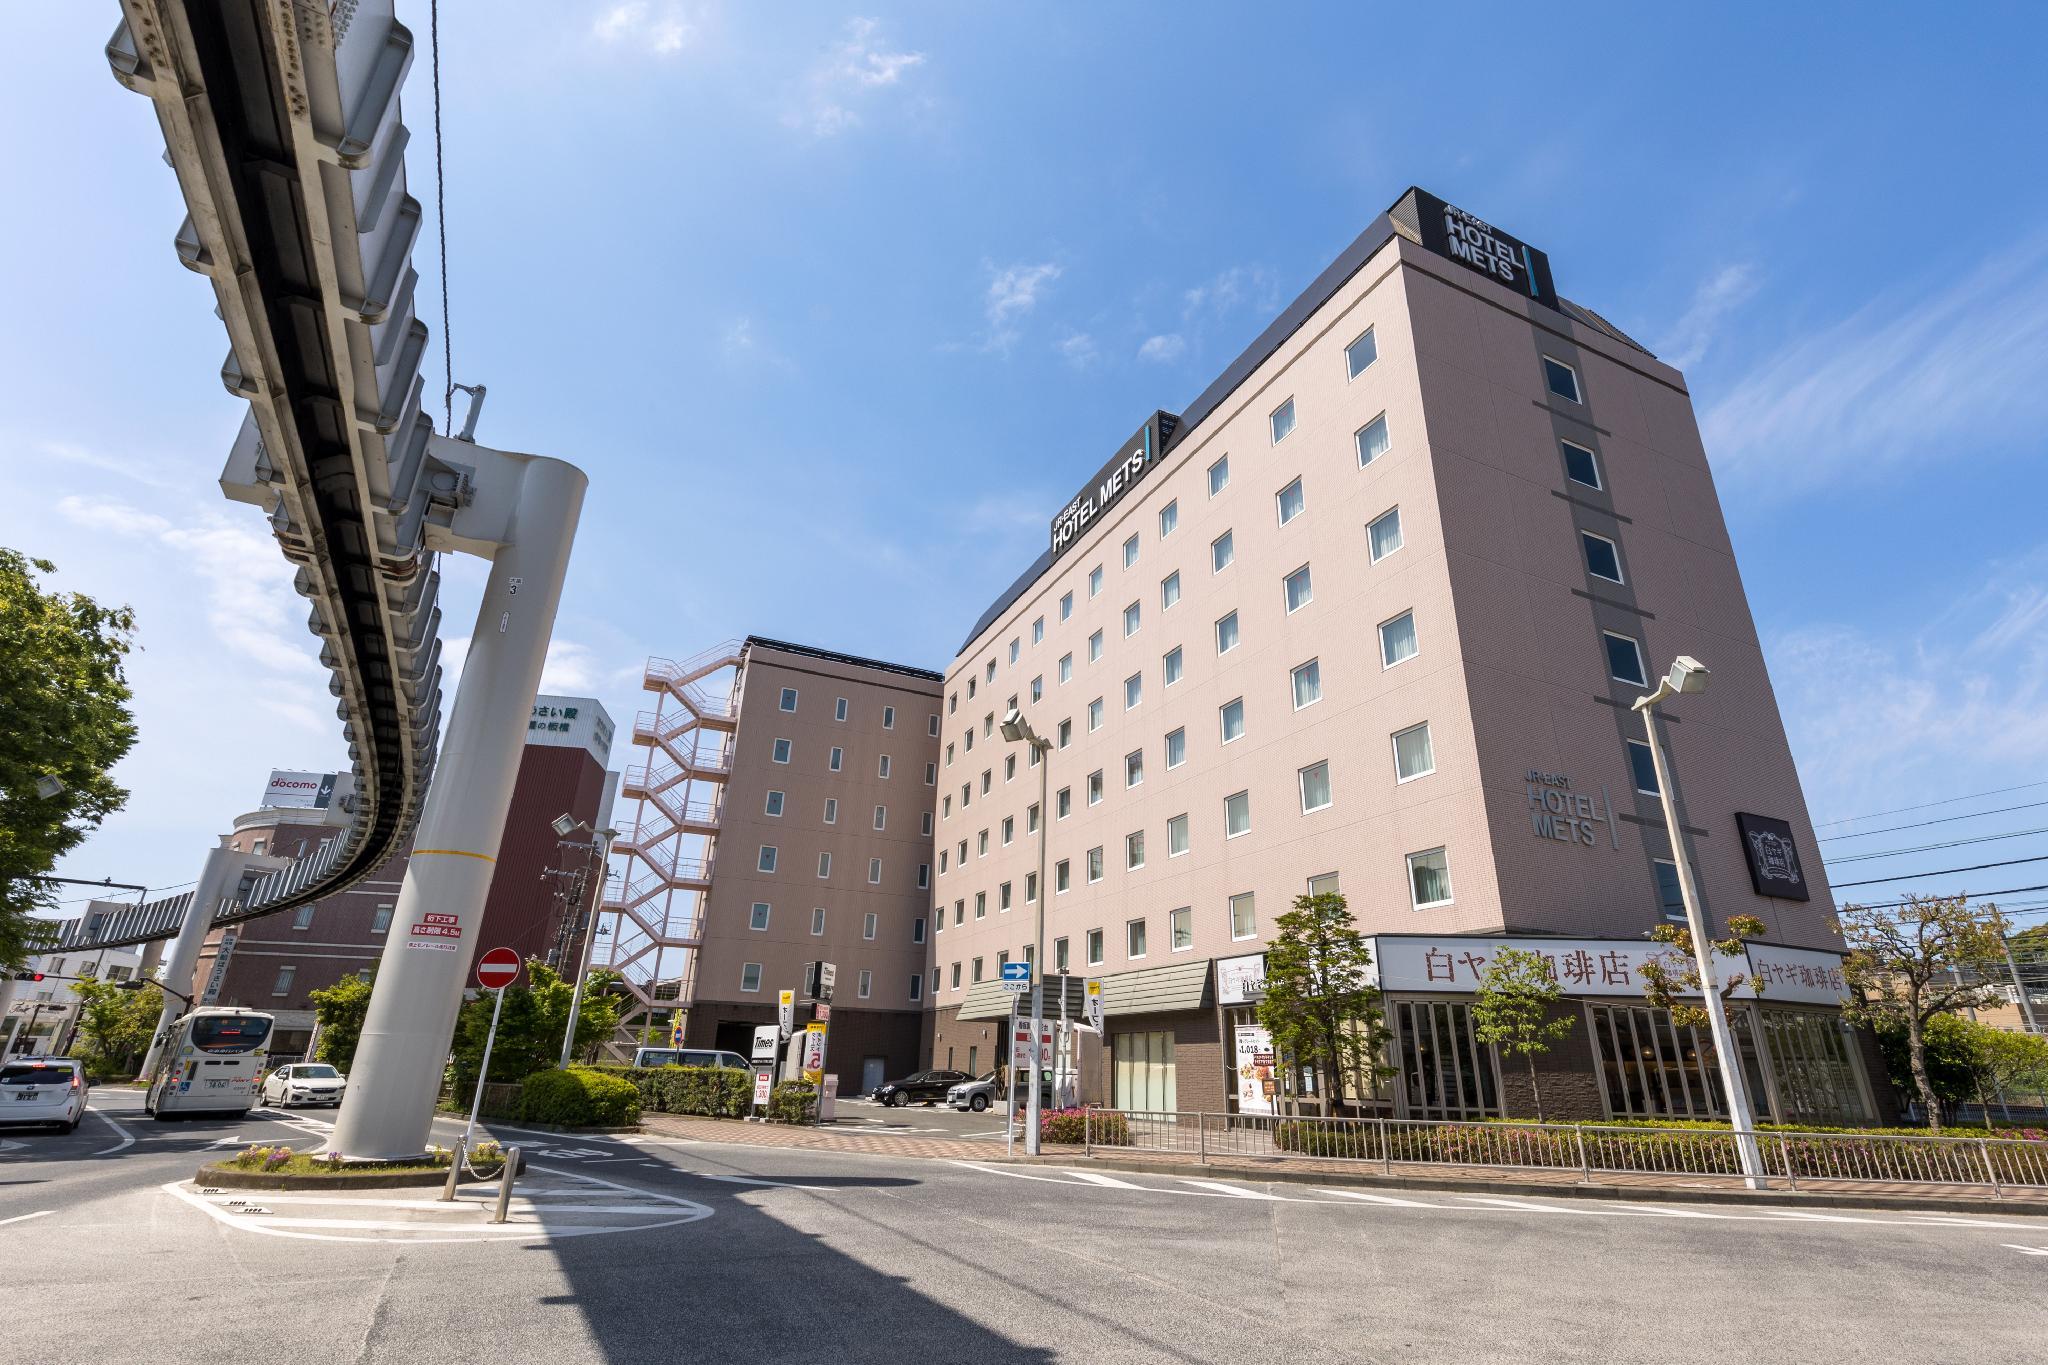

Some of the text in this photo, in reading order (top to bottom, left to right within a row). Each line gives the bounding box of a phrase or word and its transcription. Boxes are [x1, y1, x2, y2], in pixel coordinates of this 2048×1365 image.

[1445, 214, 1525, 270] HOTEL
[1449, 234, 1514, 281] METS
[1053, 448, 1144, 553] HOTEL METS
[1053, 496, 1082, 532] JR-EAST
[509, 585, 517, 595] 3
[271, 777, 317, 790] docomo
[1527, 784, 1609, 823] HOTEL
[1531, 812, 1596, 847] METS
[1425, 946, 1630, 986] 白ヤ琲店
[1757, 958, 1844, 992] 白ヤギ珈琲店
[754, 1036, 774, 1048] Times
